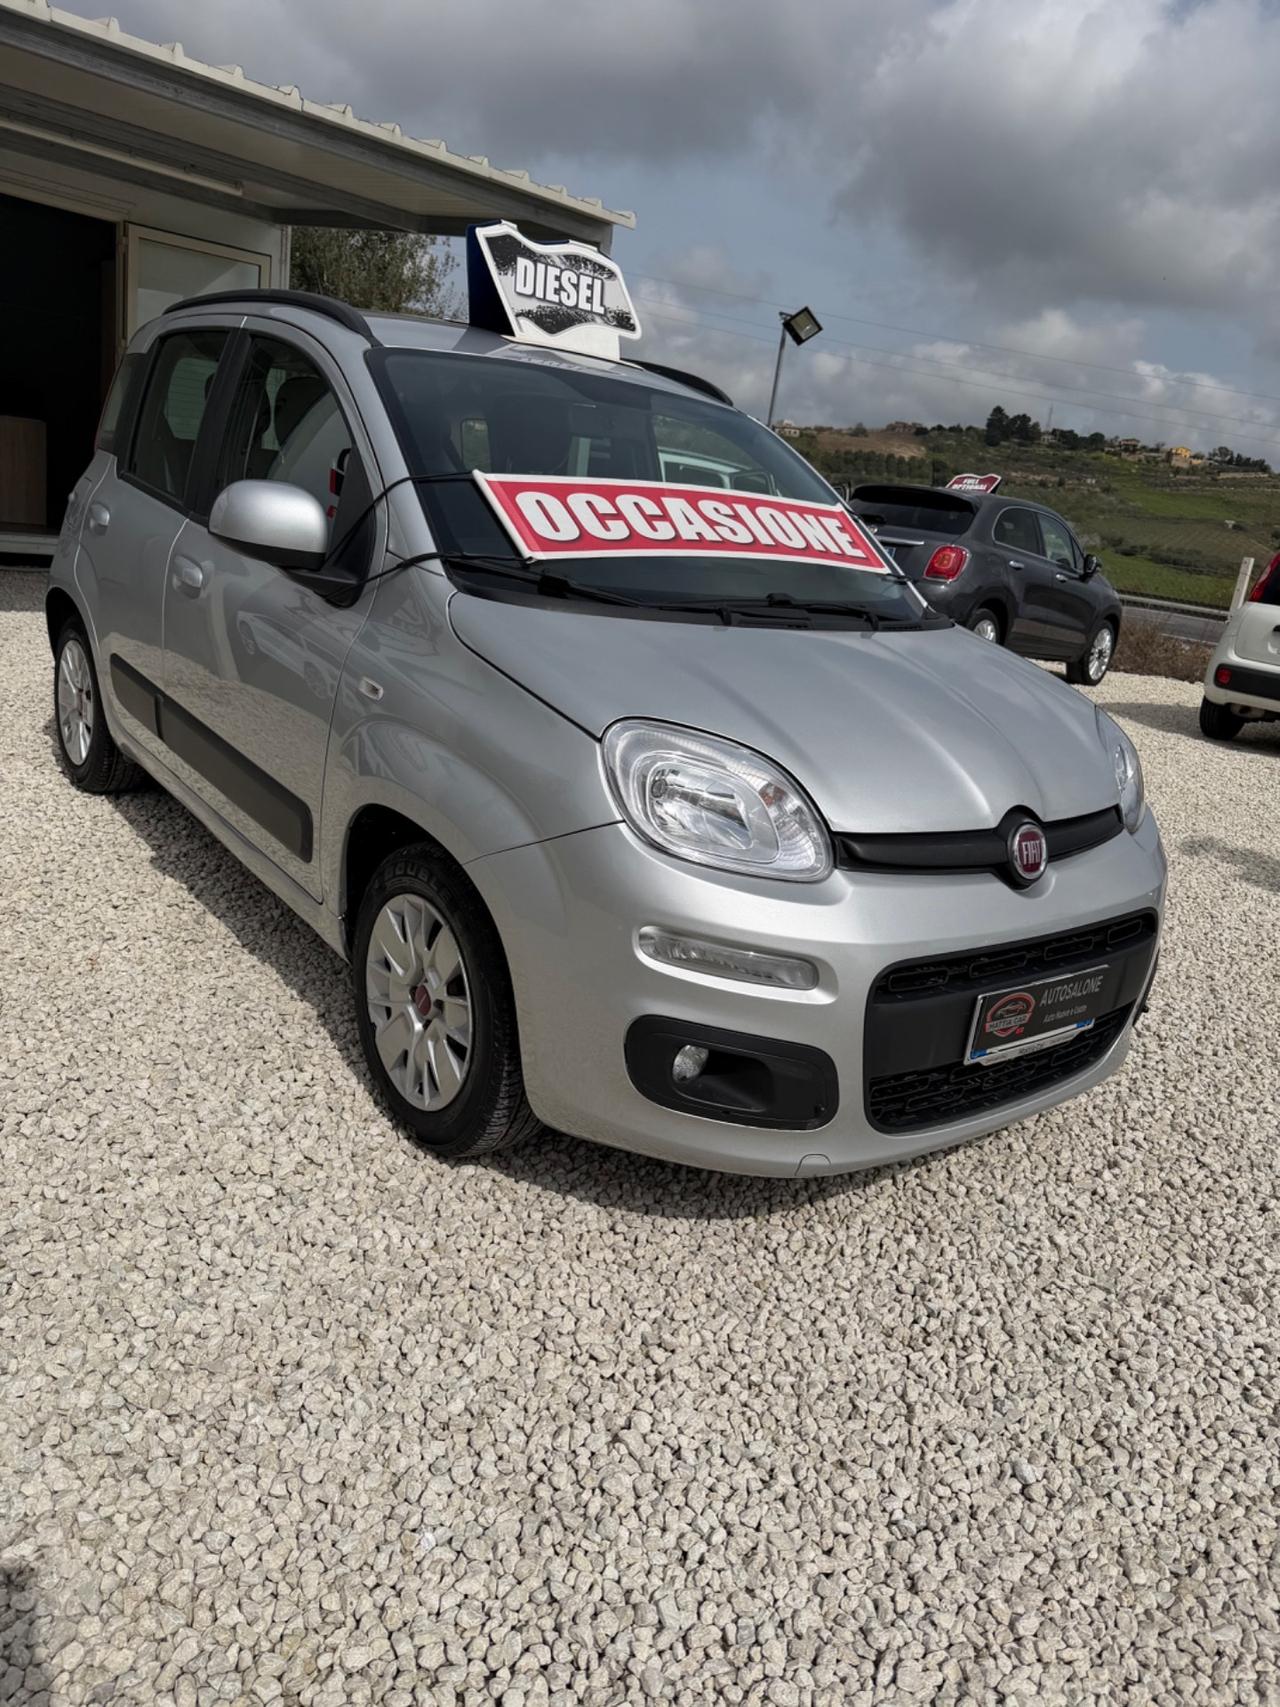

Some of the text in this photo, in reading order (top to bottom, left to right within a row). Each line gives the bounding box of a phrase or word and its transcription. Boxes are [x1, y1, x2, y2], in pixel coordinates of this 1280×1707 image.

[515, 256, 605, 314] DIESEL
[515, 491, 868, 558] OCCASIONE
[1021, 840, 1041, 865] FIAT
[1039, 976, 1103, 1006] AUTOSALONE
